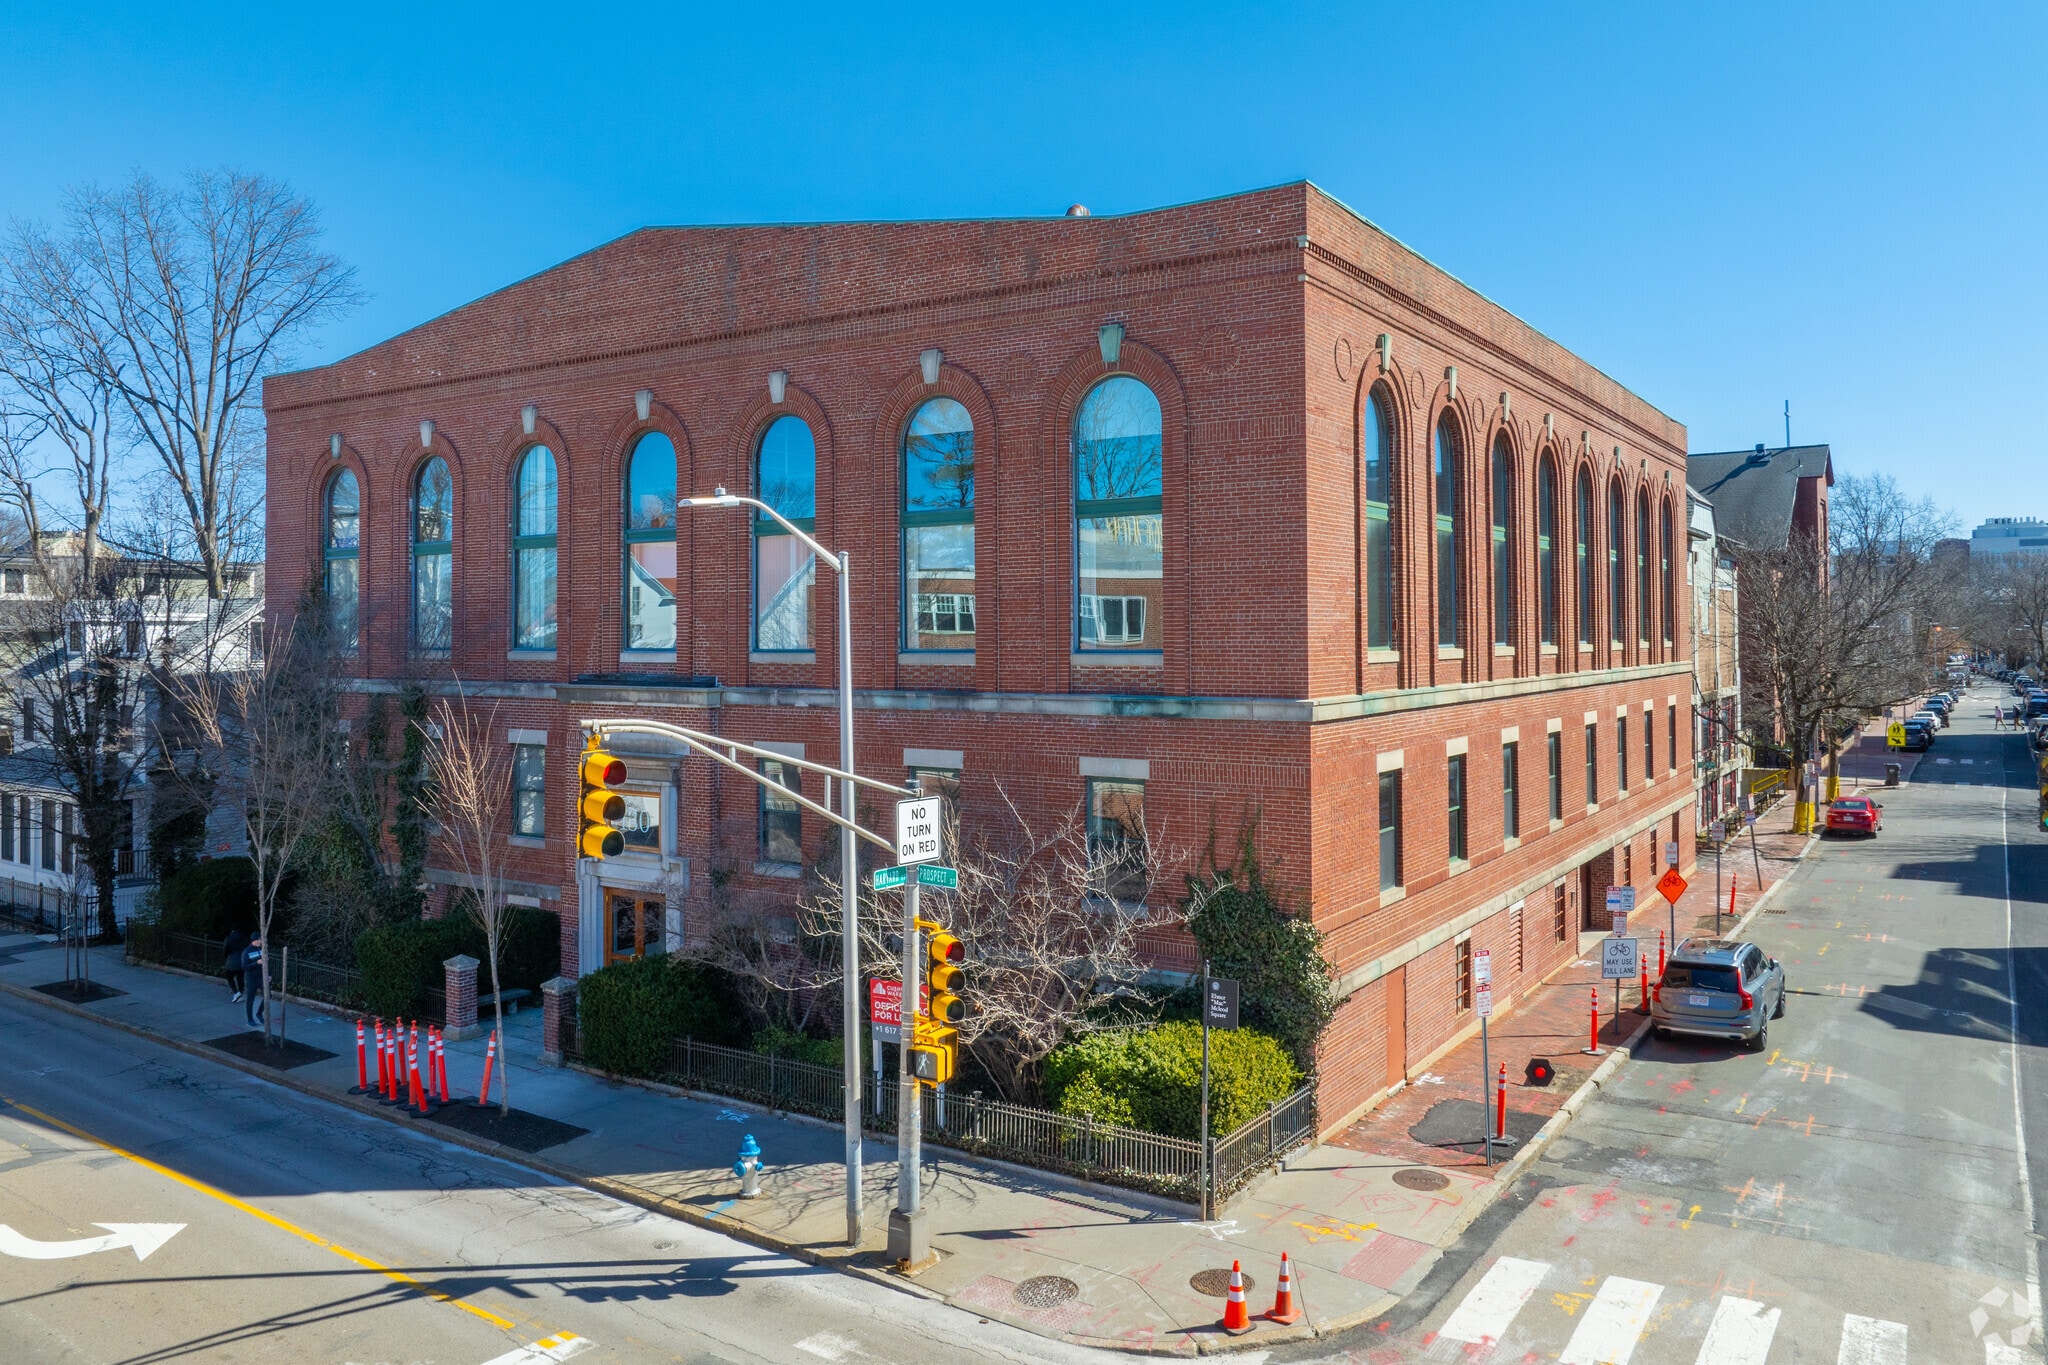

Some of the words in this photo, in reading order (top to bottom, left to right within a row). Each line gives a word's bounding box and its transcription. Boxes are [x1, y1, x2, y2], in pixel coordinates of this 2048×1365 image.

[911, 807, 926, 820] NO
[907, 823, 931, 838] TURN
[902, 843, 915, 856] ON
[919, 839, 936, 853] RED
[875, 870, 900, 887] HARVARD
[919, 867, 947, 884] PROSPECT
[1606, 958, 1620, 966] MAY
[1621, 958, 1633, 966] USE
[1604, 967, 1618, 975] FULL
[1619, 967, 1635, 975] LANE
[874, 1010, 893, 1021] FOR
[875, 1025, 883, 1033] +1
[884, 1026, 897, 1035] 617
